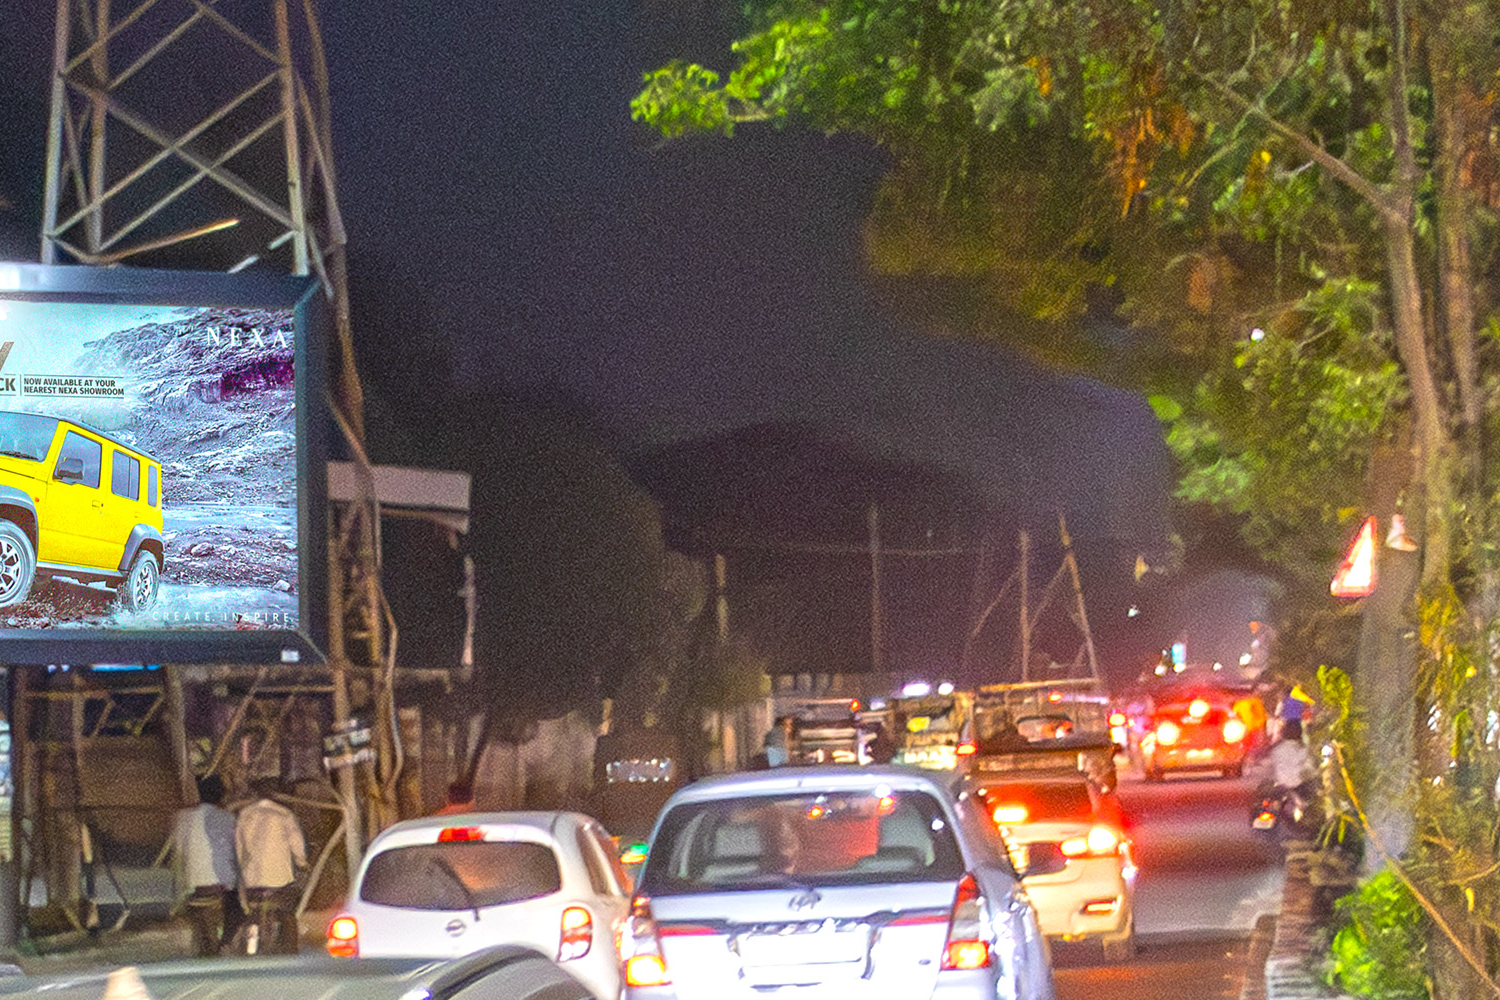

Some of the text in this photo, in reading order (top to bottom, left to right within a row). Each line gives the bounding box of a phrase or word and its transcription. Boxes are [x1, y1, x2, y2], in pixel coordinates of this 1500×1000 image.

[206, 326, 288, 348] NEXA
[23, 377, 116, 388] NOW AVAILABLE AT YOUR
[23, 386, 125, 396] NEAREST NEXA SHOWROOM
[152, 611, 216, 622] CREATE.
